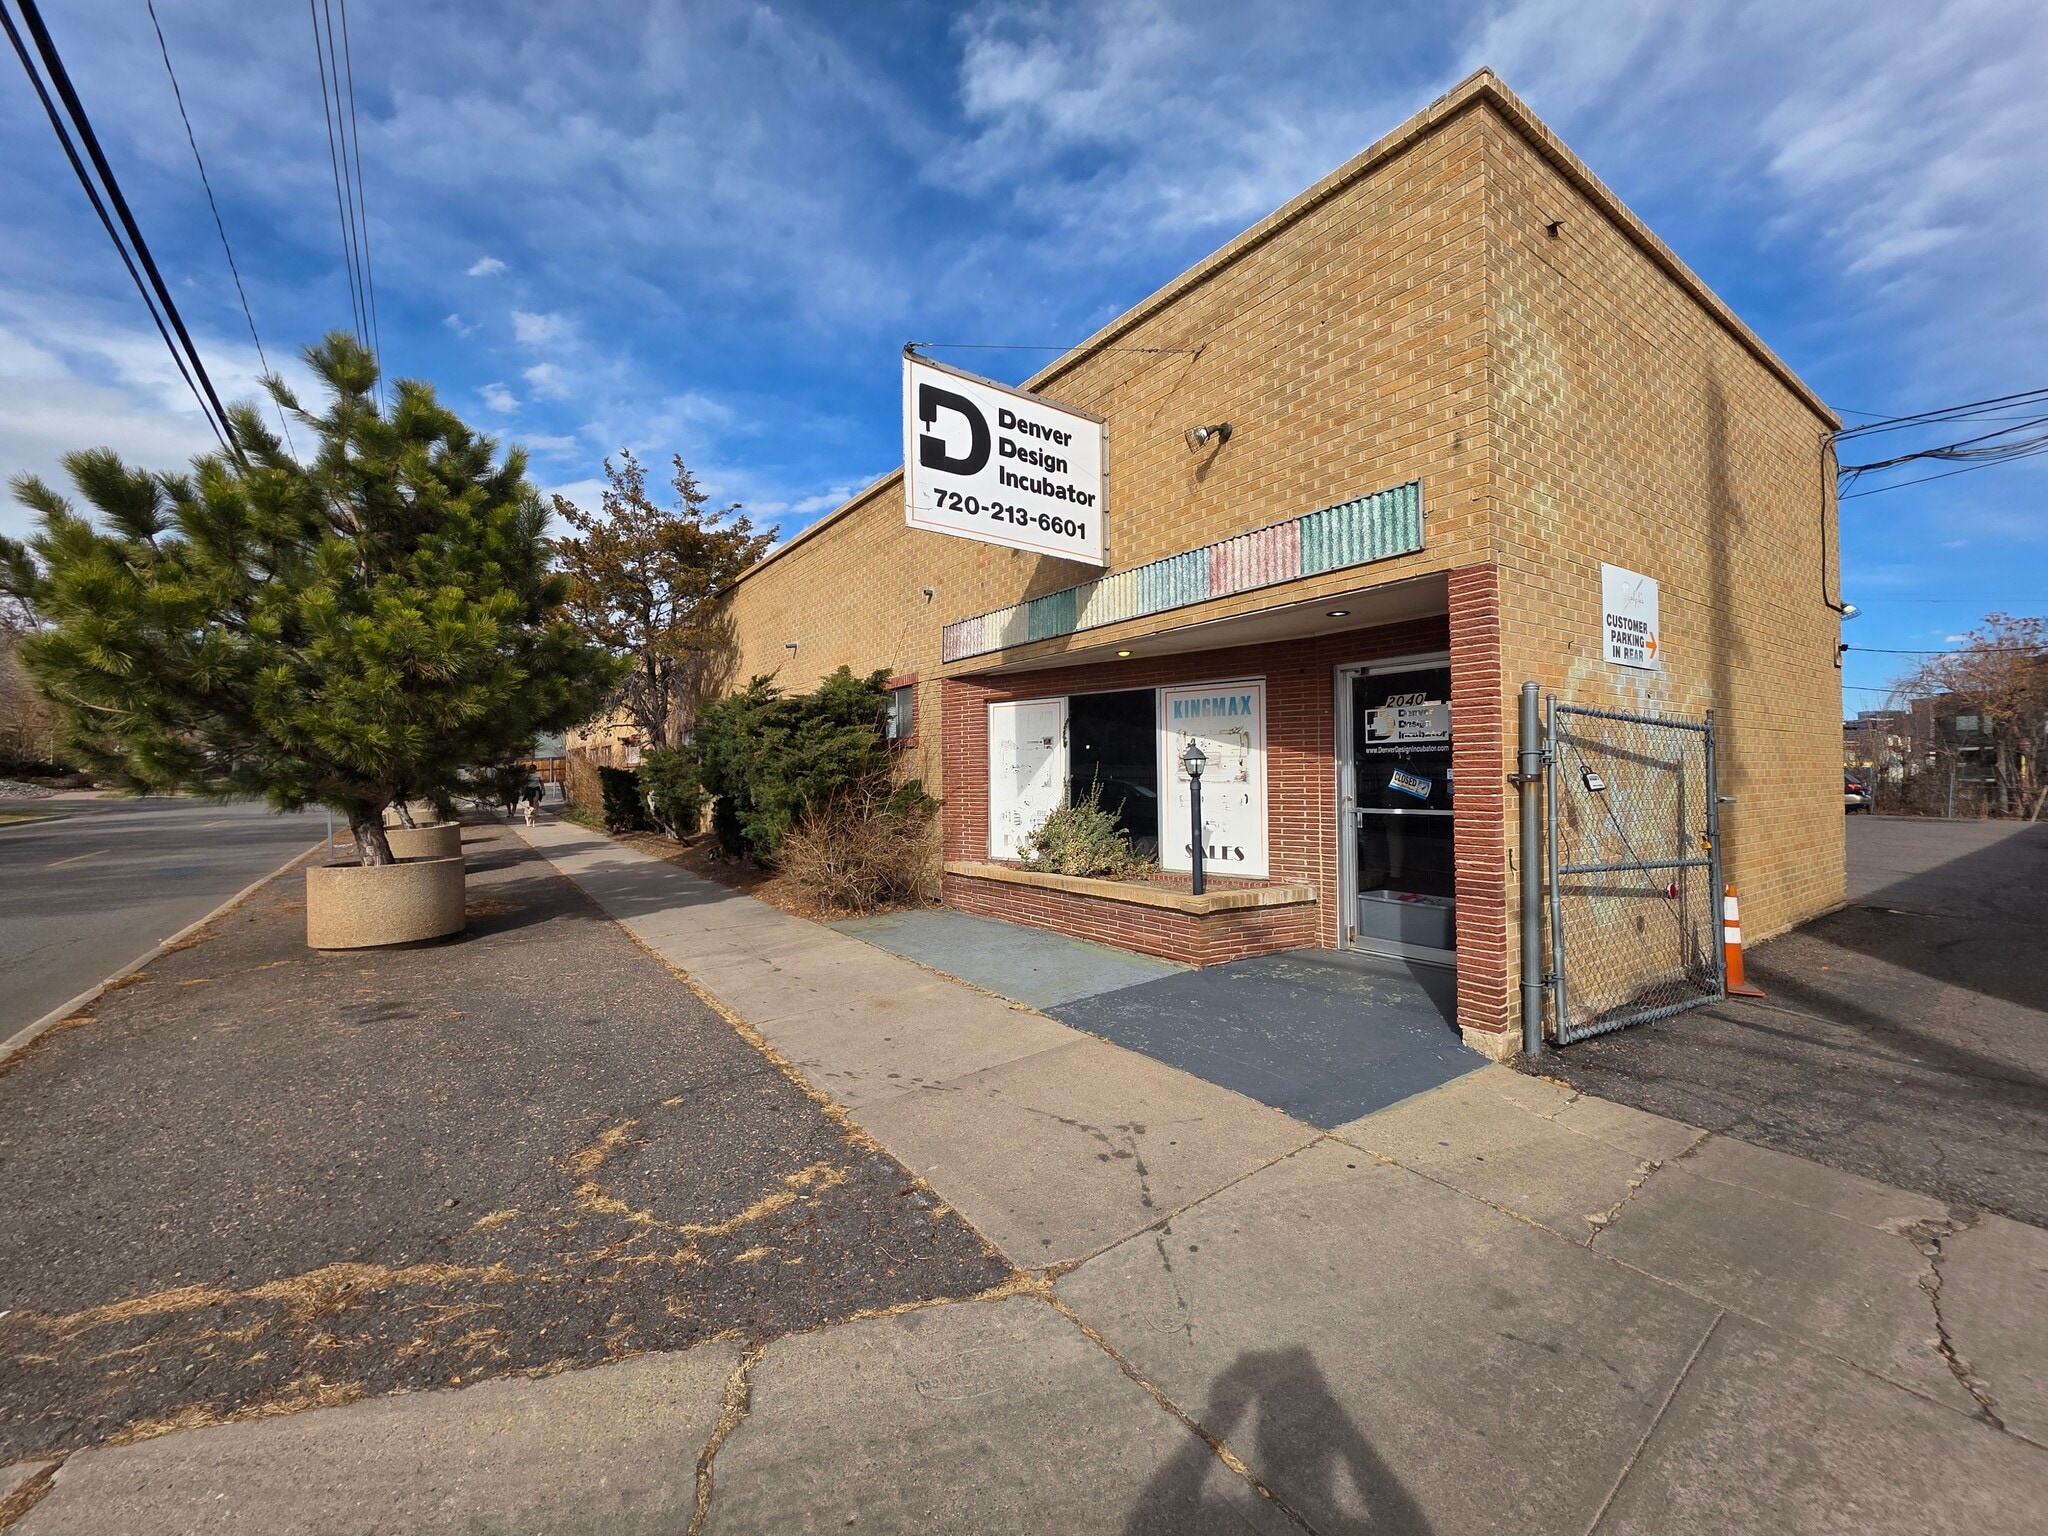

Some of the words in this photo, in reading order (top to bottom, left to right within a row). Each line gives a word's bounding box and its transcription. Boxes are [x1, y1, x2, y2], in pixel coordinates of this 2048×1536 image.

[998, 407, 1072, 447] Denver
[999, 436, 1068, 474] Design
[999, 465, 1096, 508] Incubator
[933, 487, 1086, 540] 720-213-6601
[1606, 613, 1648, 634] CUSTOMER
[1610, 629, 1645, 648] PARKING
[1612, 645, 1621, 658] IN
[1624, 647, 1644, 663] REAR
[1173, 695, 1252, 719] KINGMAX
[1386, 694, 1424, 708] 2040
[1393, 772, 1418, 787] CLOSED
